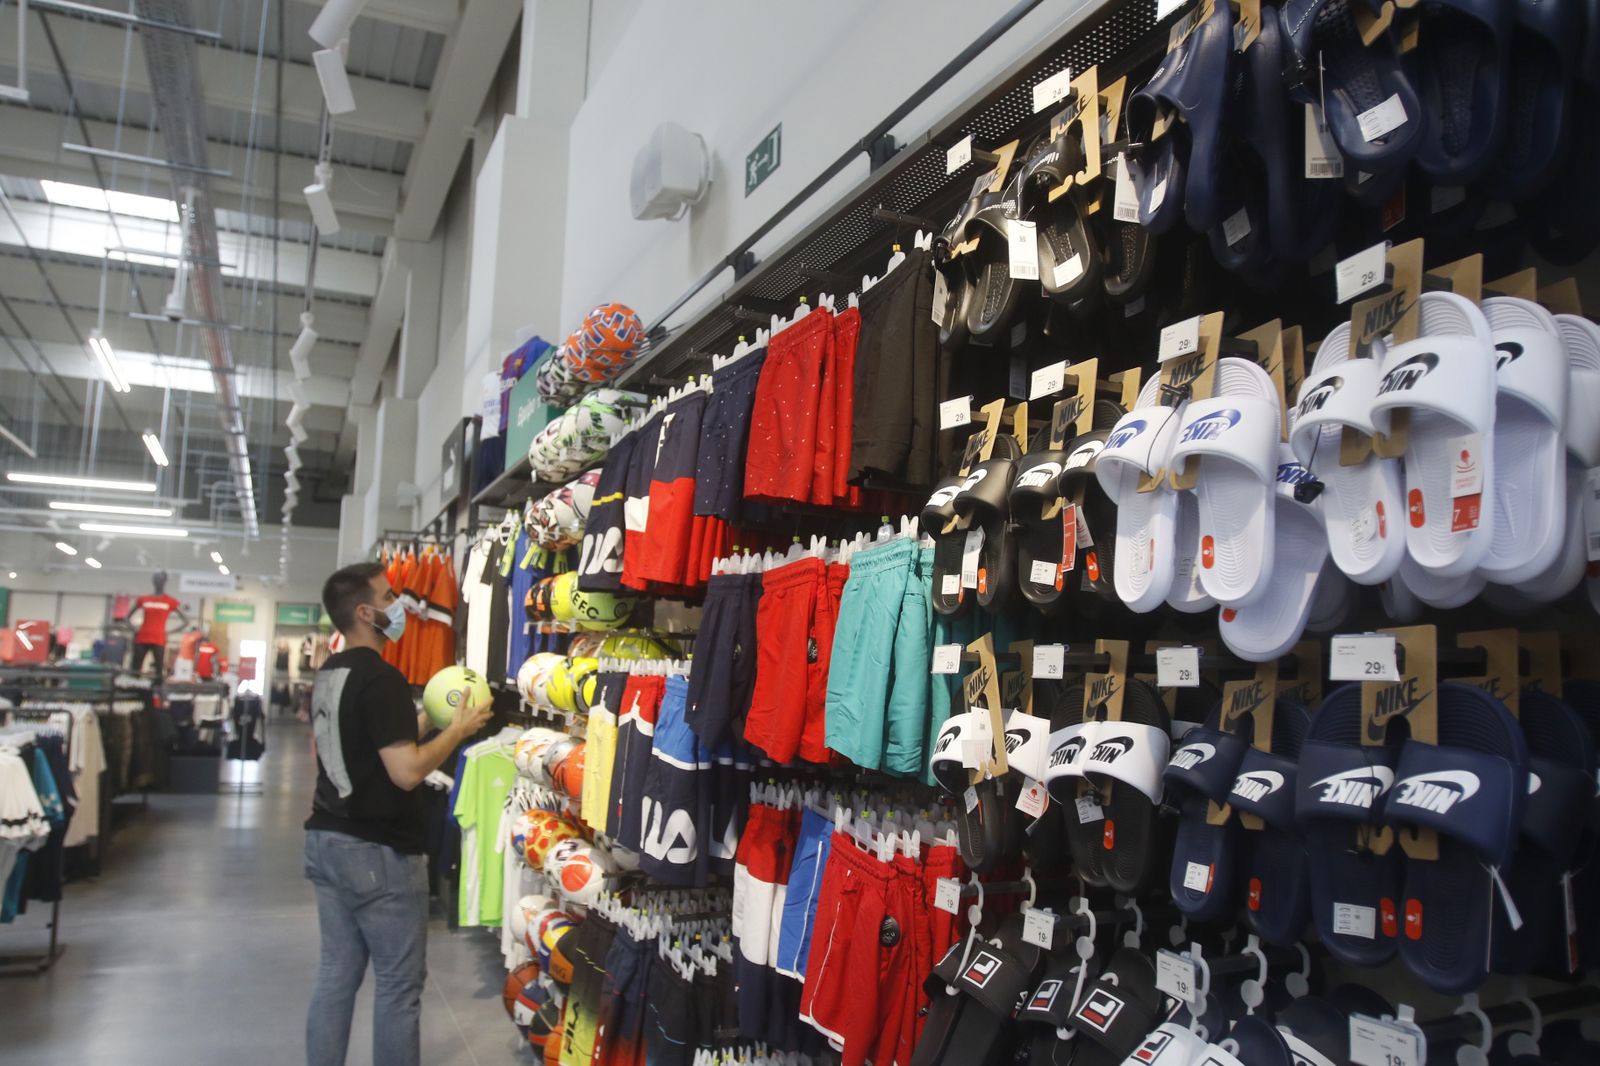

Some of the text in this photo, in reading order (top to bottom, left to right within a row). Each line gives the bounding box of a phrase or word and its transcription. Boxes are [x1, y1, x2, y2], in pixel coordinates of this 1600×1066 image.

[1363, 289, 1406, 338] NIKE
[1169, 352, 1206, 386] NIKE
[1060, 393, 1085, 427] NIKE
[968, 665, 988, 698] NIKE
[1091, 674, 1116, 700] NIKE
[1231, 680, 1265, 713] NIKE
[1374, 677, 1419, 717] NIKE
[1048, 748, 1078, 769] NIKE
[1089, 744, 1122, 764] NIKE
[1231, 776, 1271, 803] NIKE
[1319, 778, 1383, 809] NIKE
[1395, 780, 1462, 815] NIKE
